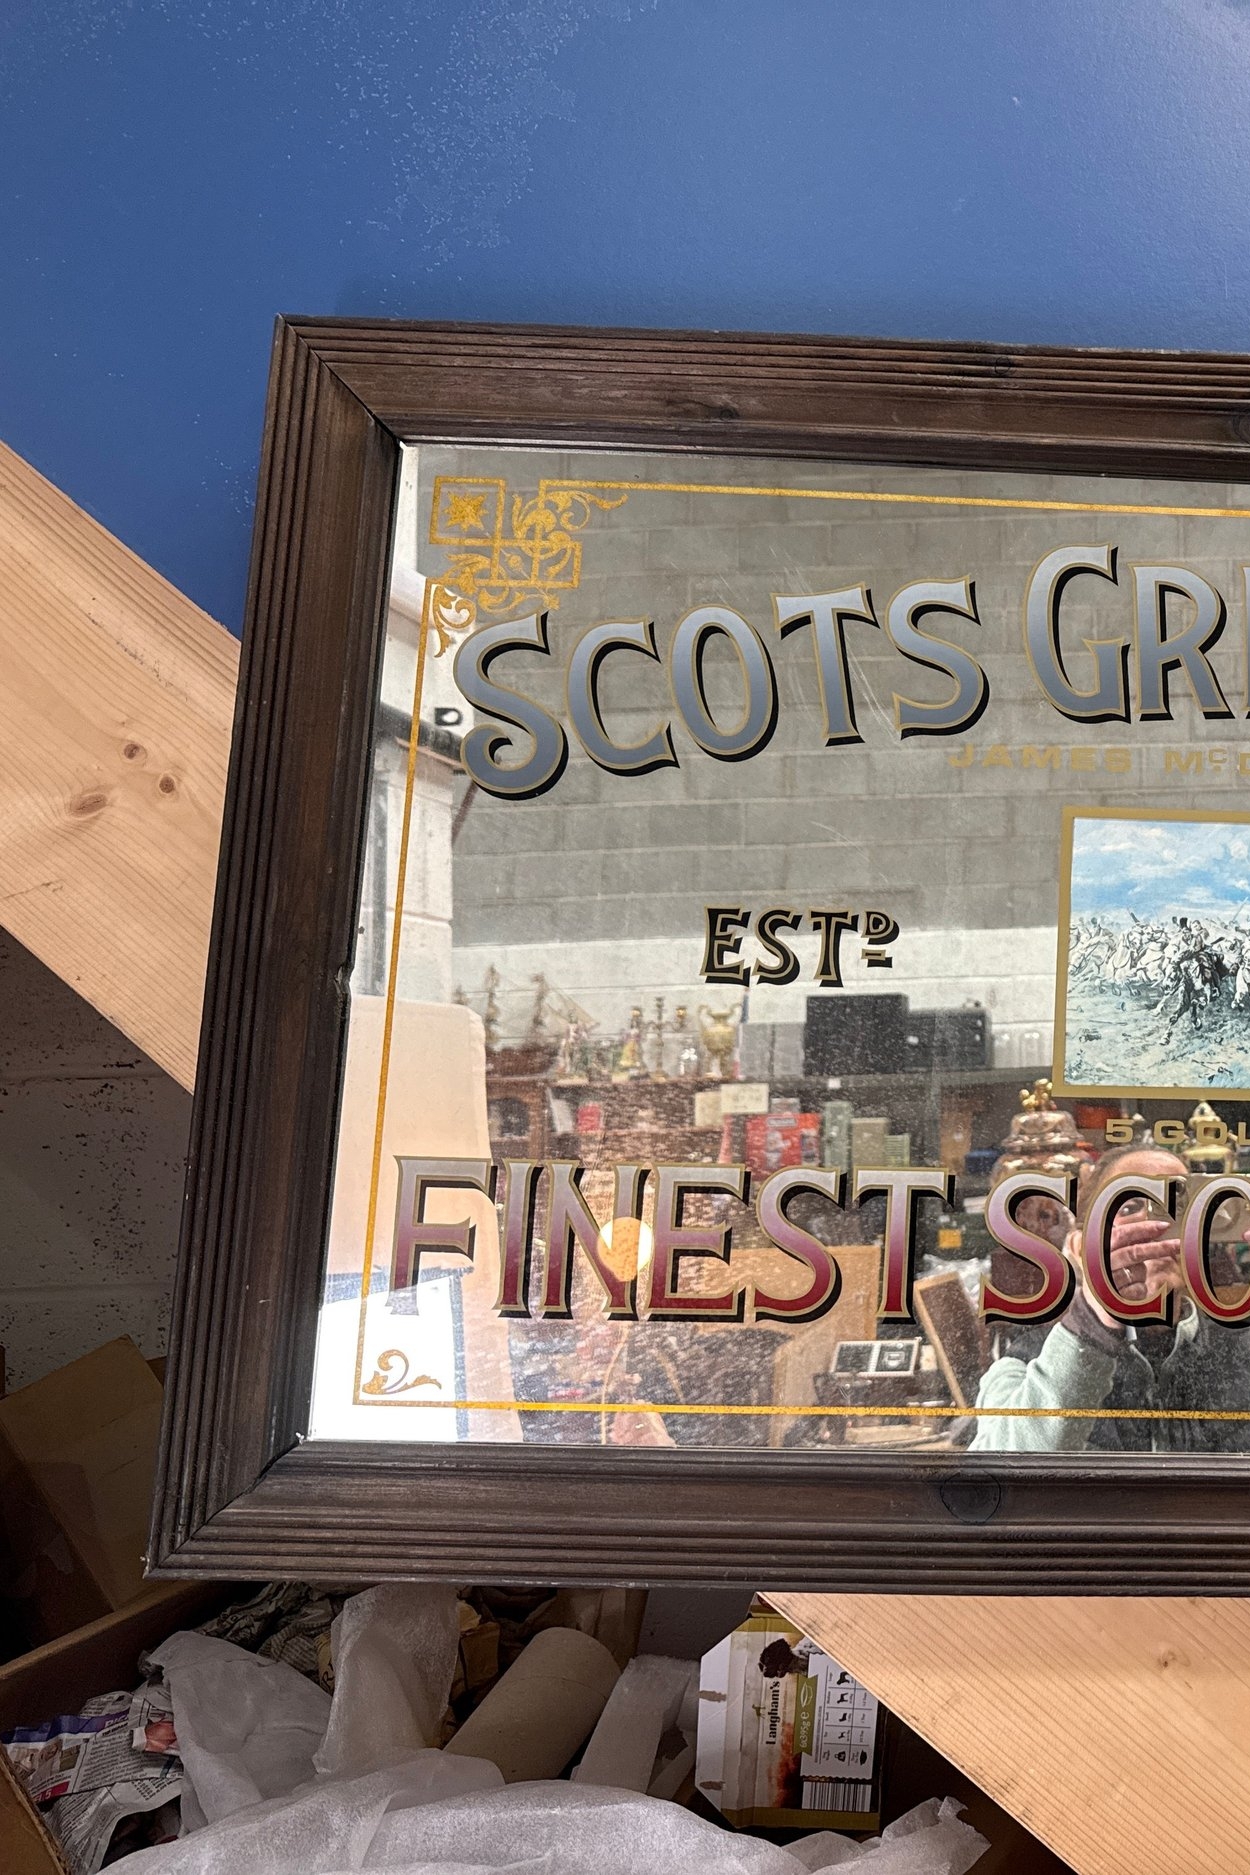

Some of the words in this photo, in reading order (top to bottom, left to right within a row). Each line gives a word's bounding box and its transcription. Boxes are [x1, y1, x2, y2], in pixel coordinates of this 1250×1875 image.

[453, 574, 990, 800] SCOTS
[950, 743, 1132, 773] JAMES
[1105, 1119, 1134, 1144] 5
[385, 1155, 956, 1325] FINEST
[765, 1681, 780, 1745] Langham's
